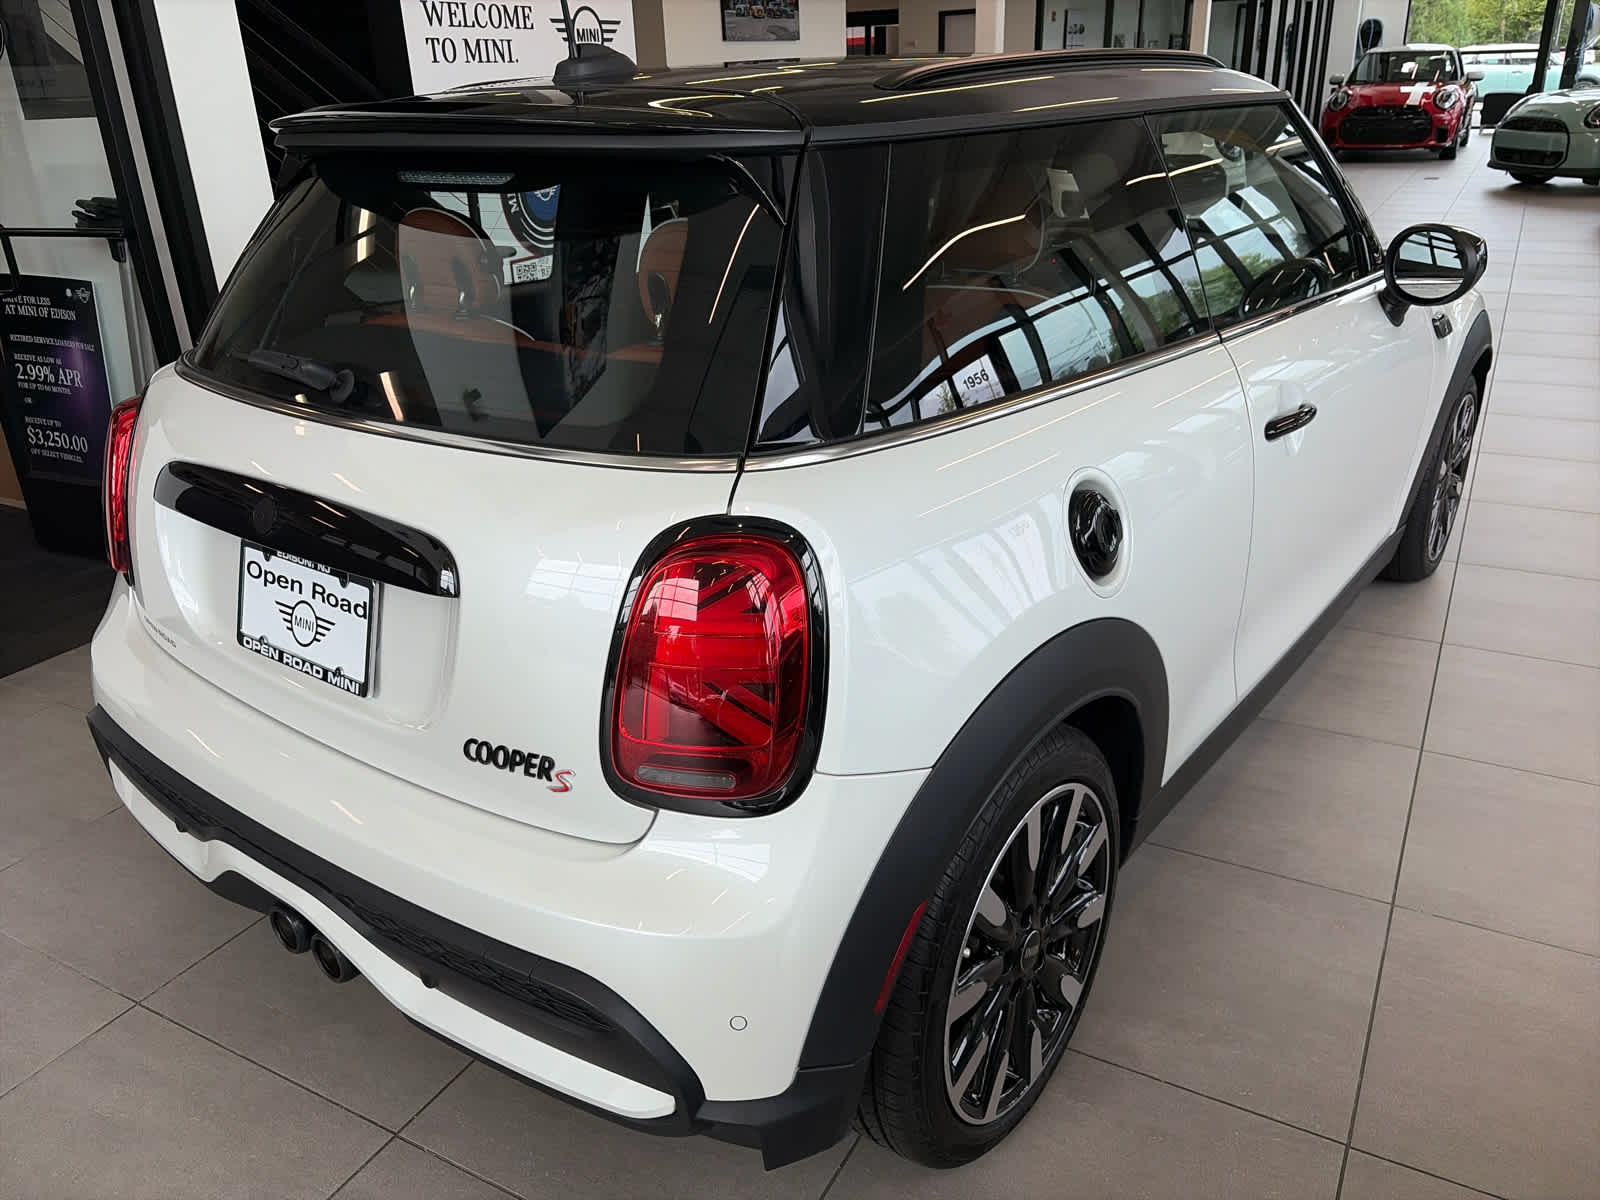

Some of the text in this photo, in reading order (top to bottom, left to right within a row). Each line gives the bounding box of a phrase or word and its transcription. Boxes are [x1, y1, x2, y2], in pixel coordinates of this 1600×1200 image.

[420, 0, 535, 30] WELCOME
[576, 28, 600, 43] MINI
[425, 37, 519, 63] TO MINI.
[5, 304, 77, 321] AT MINI OF EDISON
[36, 296, 51, 306] LESS
[15, 363, 84, 389] 2.99% APR
[963, 368, 989, 390] 1956
[27, 425, 88, 453] $3,250.00
[317, 563, 331, 574] NJ
[246, 560, 368, 620] Open Road
[293, 614, 314, 633] MINI
[242, 636, 360, 694] OPEN ROAD MINI
[463, 738, 576, 792] COOPER S
